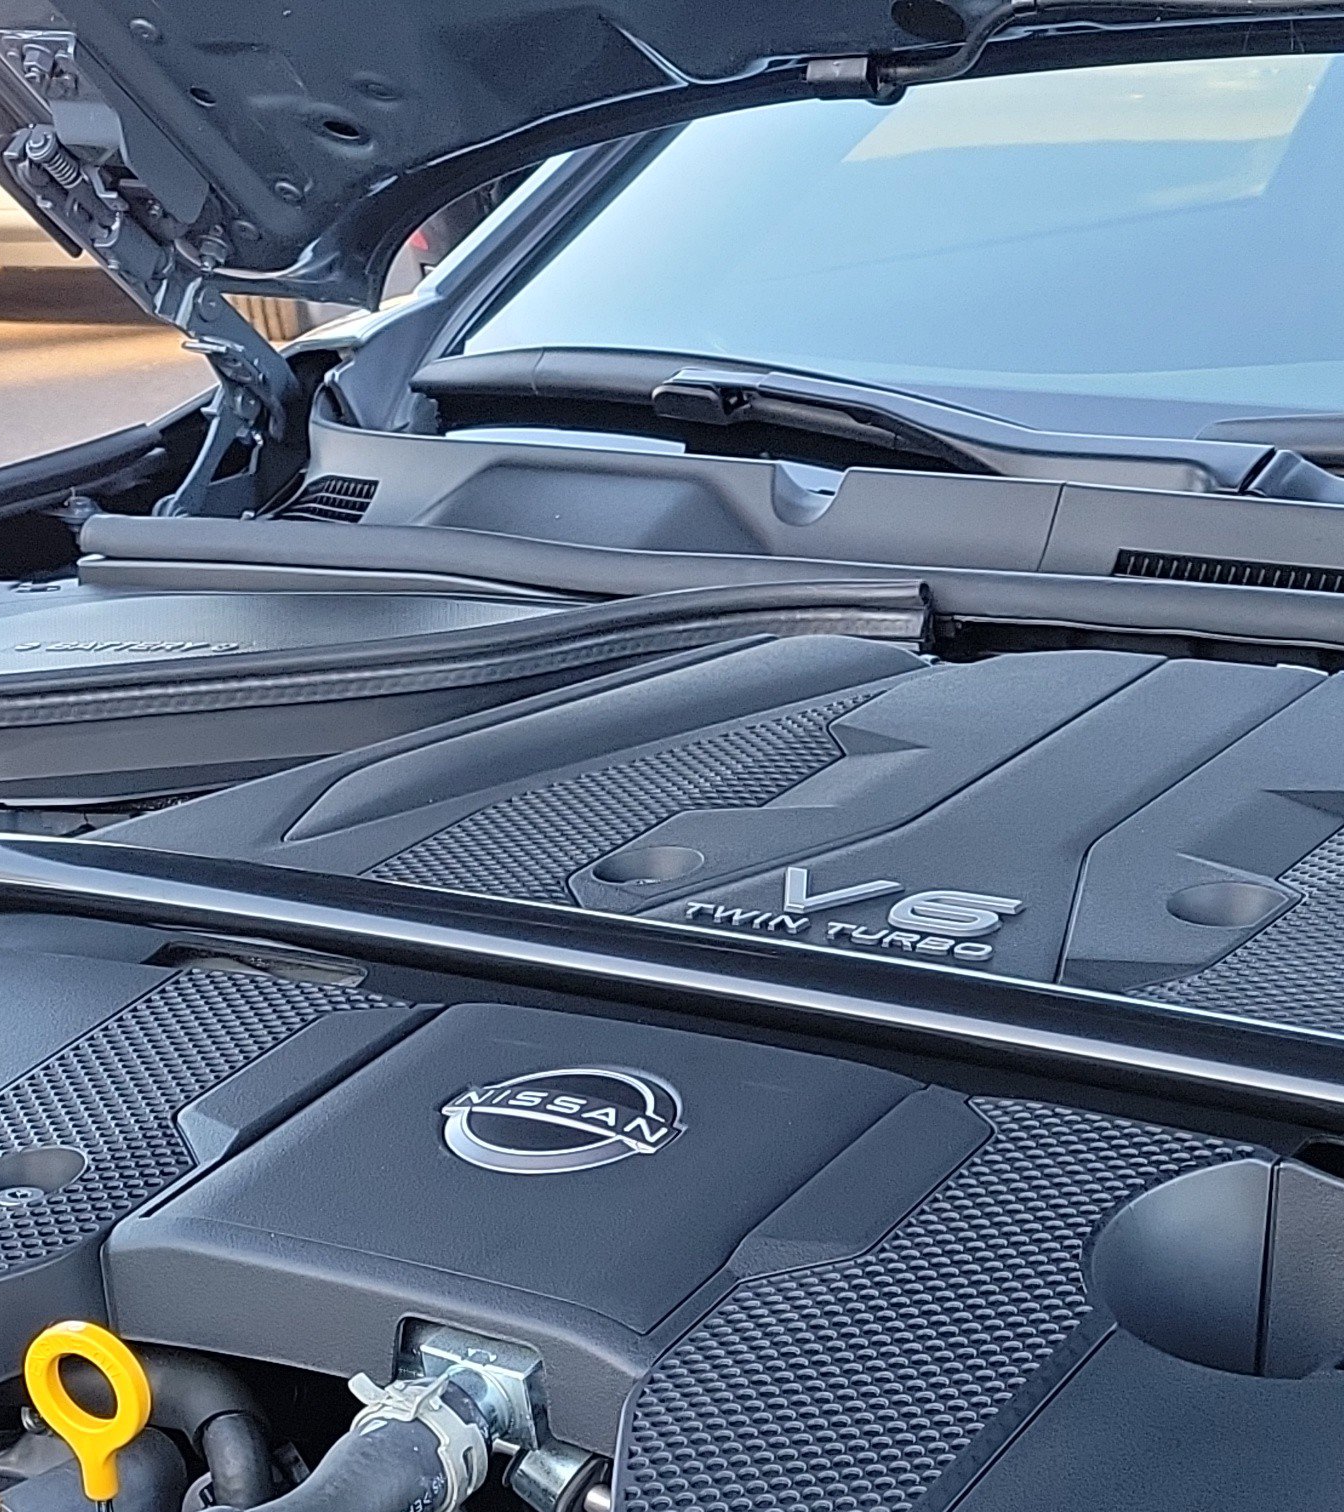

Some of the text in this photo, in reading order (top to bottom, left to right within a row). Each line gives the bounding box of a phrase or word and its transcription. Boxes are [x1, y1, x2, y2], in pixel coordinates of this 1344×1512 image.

[685, 901, 995, 961] TWIN TURBO
[784, 866, 1027, 937] V6
[454, 1089, 668, 1143] NISSAN
